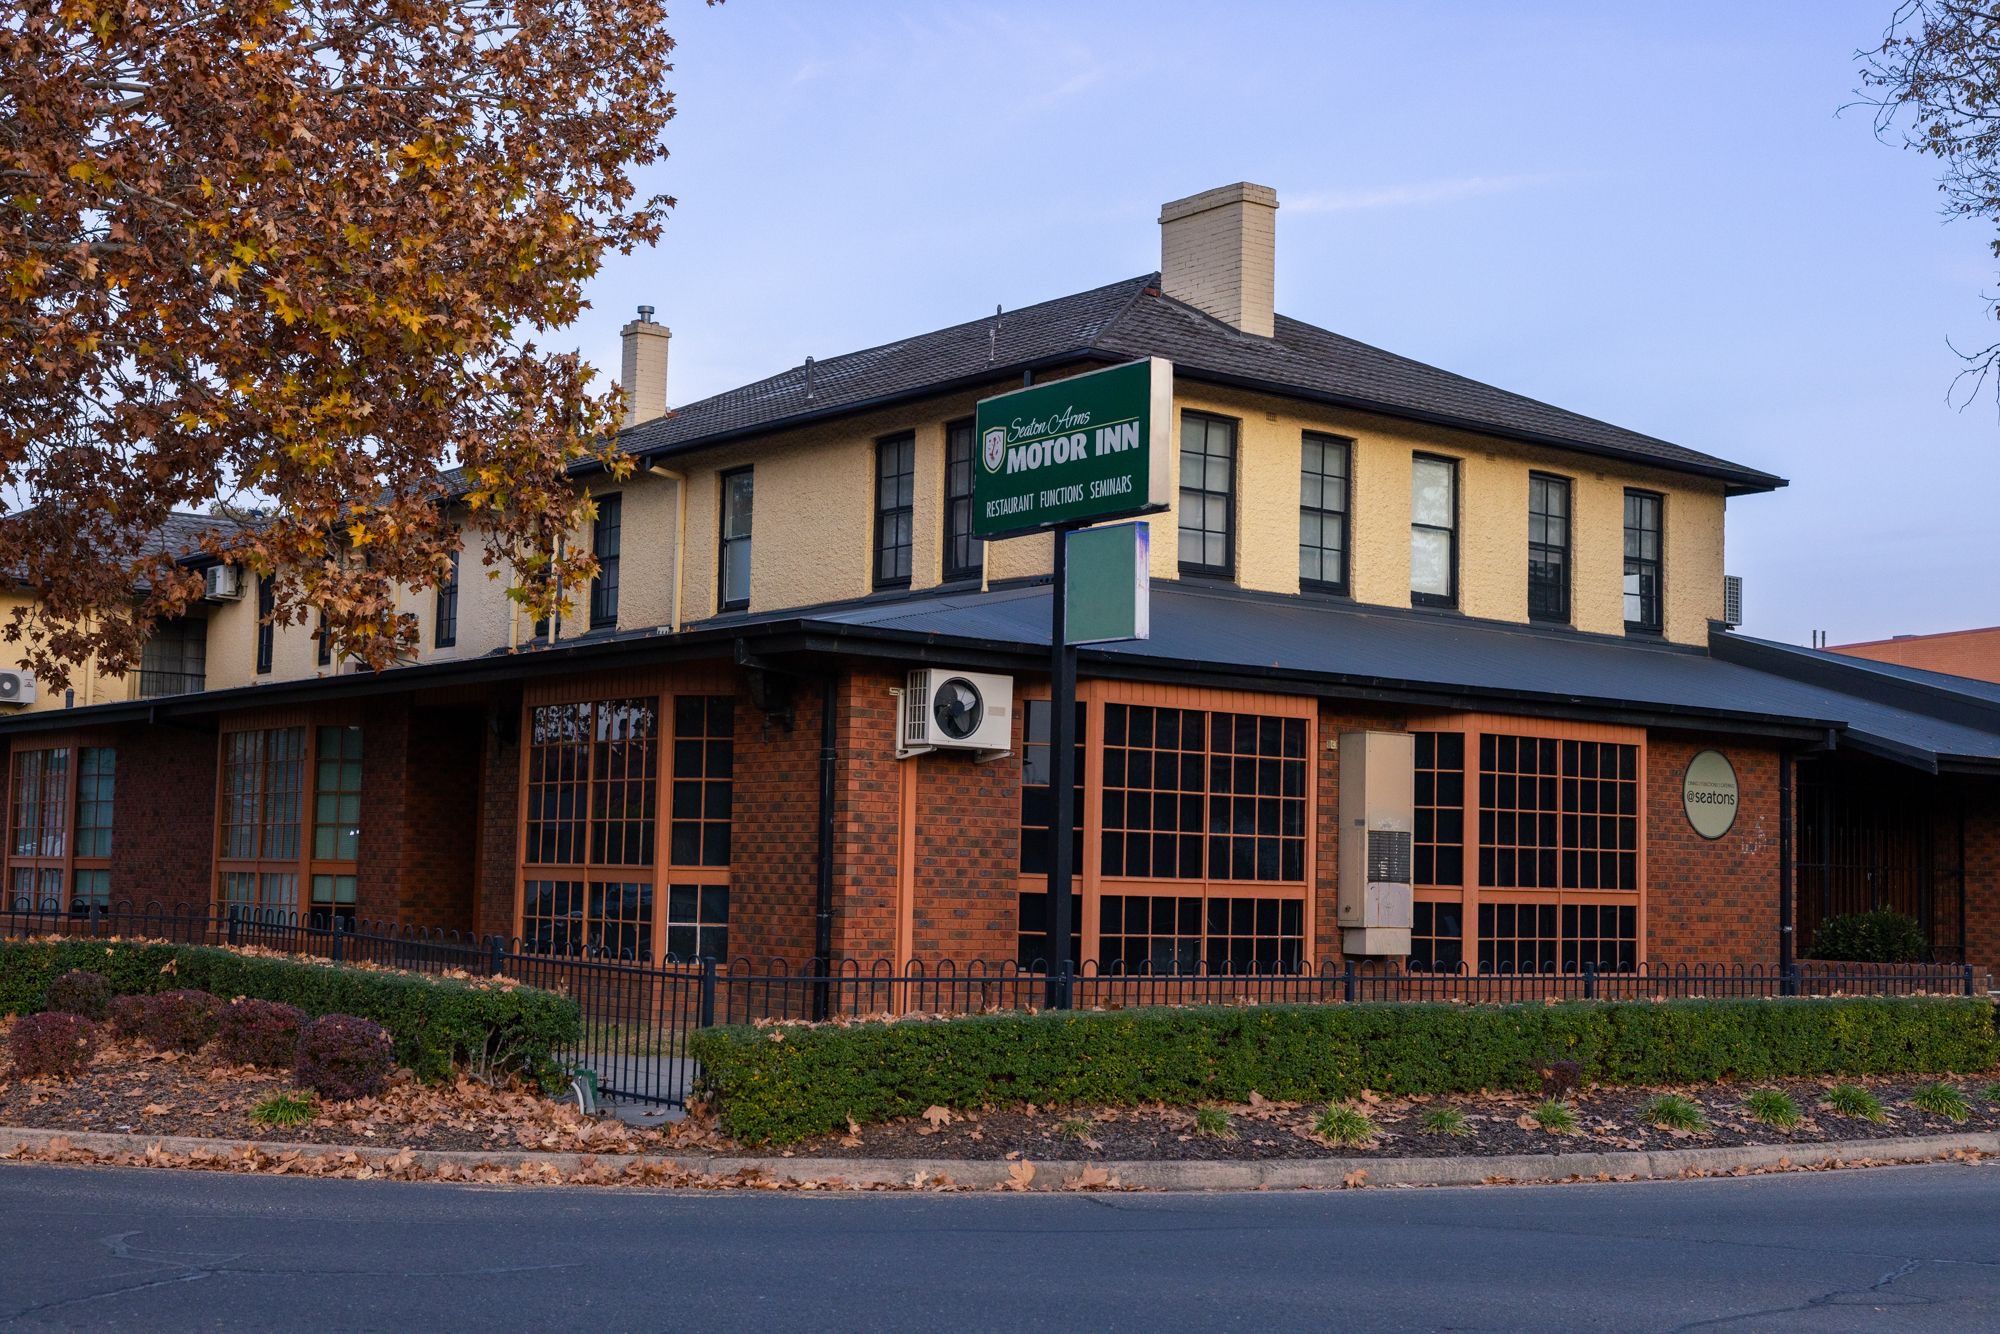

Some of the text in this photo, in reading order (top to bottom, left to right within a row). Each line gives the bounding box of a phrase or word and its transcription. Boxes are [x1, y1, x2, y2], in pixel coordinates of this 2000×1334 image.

[1007, 405, 1091, 442] Seaton Arms
[1006, 421, 1139, 474] MOTOR INN
[986, 475, 1132, 518] RESTAURANT FUNCTIONS SEMINARS
[1687, 790, 1735, 805] @seatons
